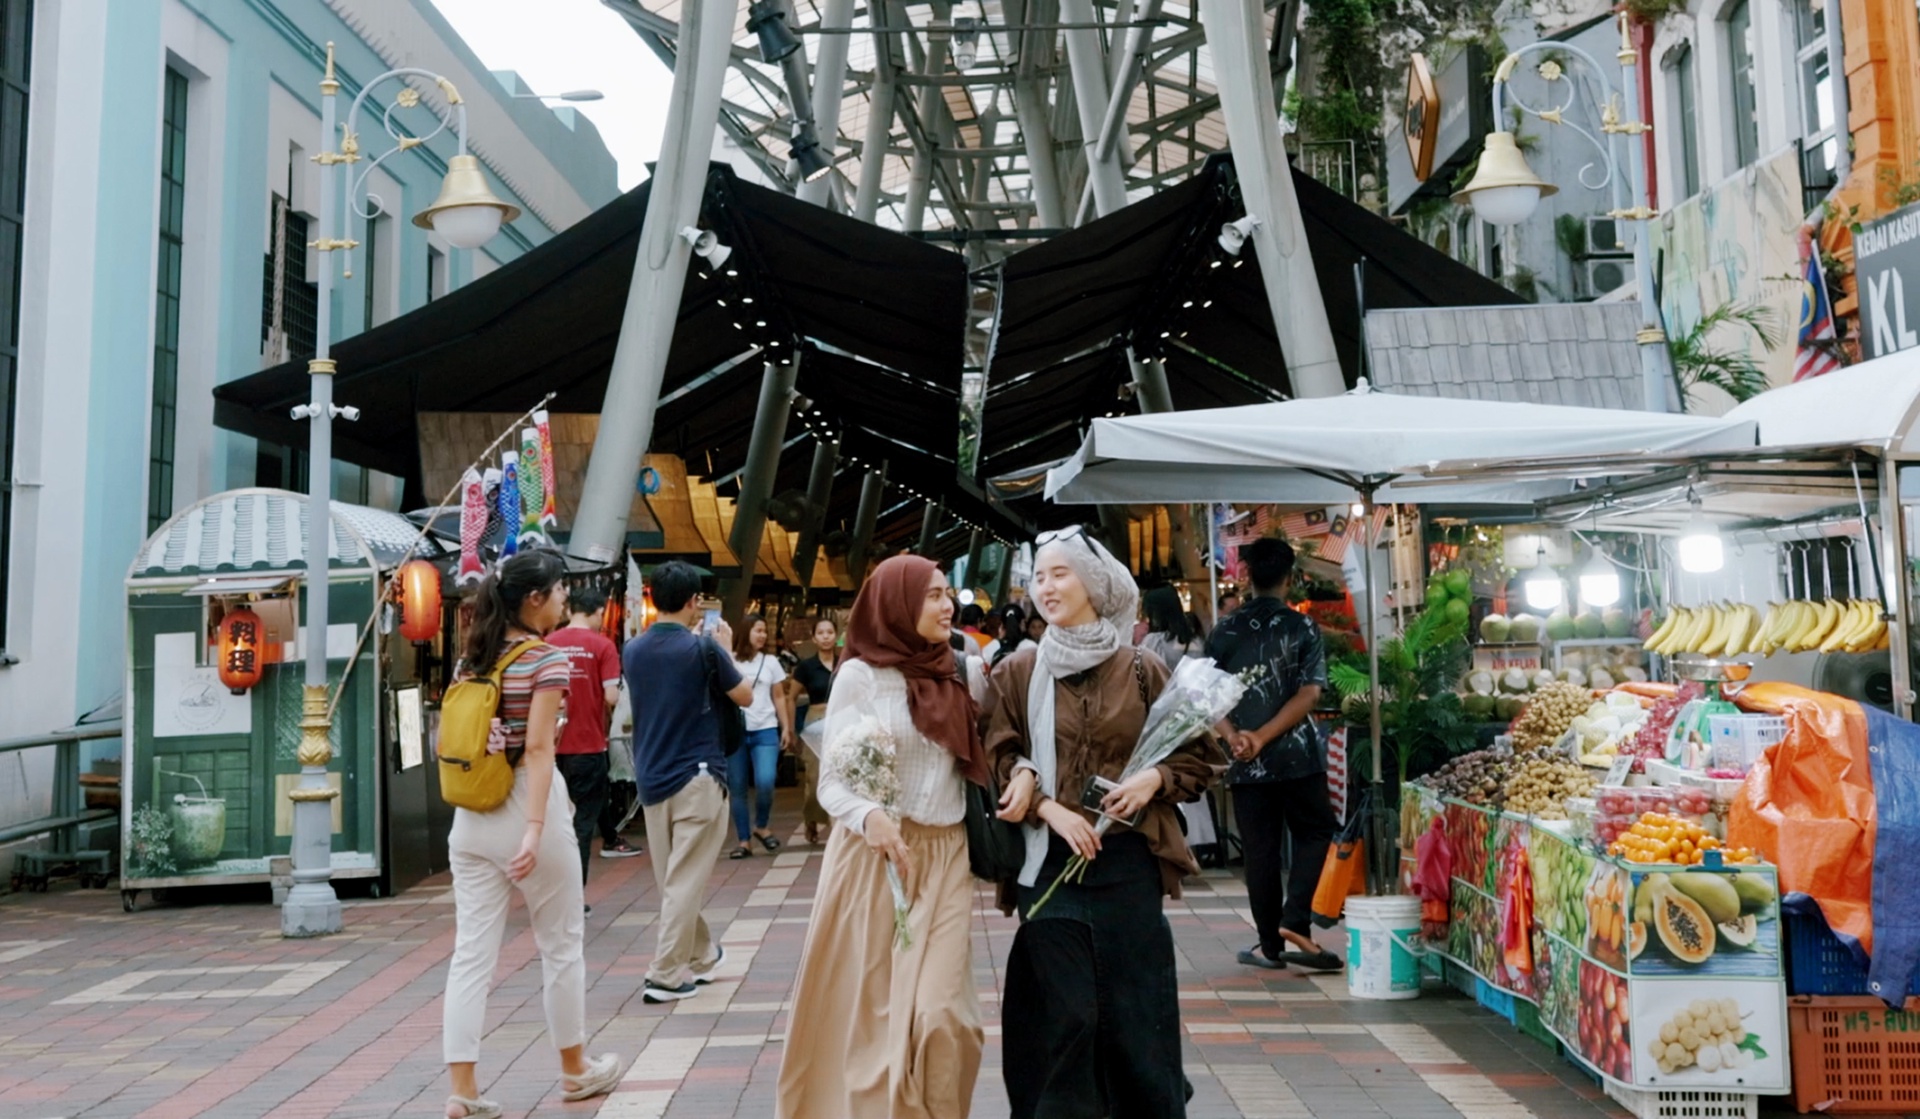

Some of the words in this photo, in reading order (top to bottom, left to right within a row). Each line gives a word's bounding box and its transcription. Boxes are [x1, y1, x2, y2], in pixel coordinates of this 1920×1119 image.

[1856, 223, 1888, 259] KEDAI
[1867, 266, 1918, 357] KL
[227, 621, 256, 673] 料理
